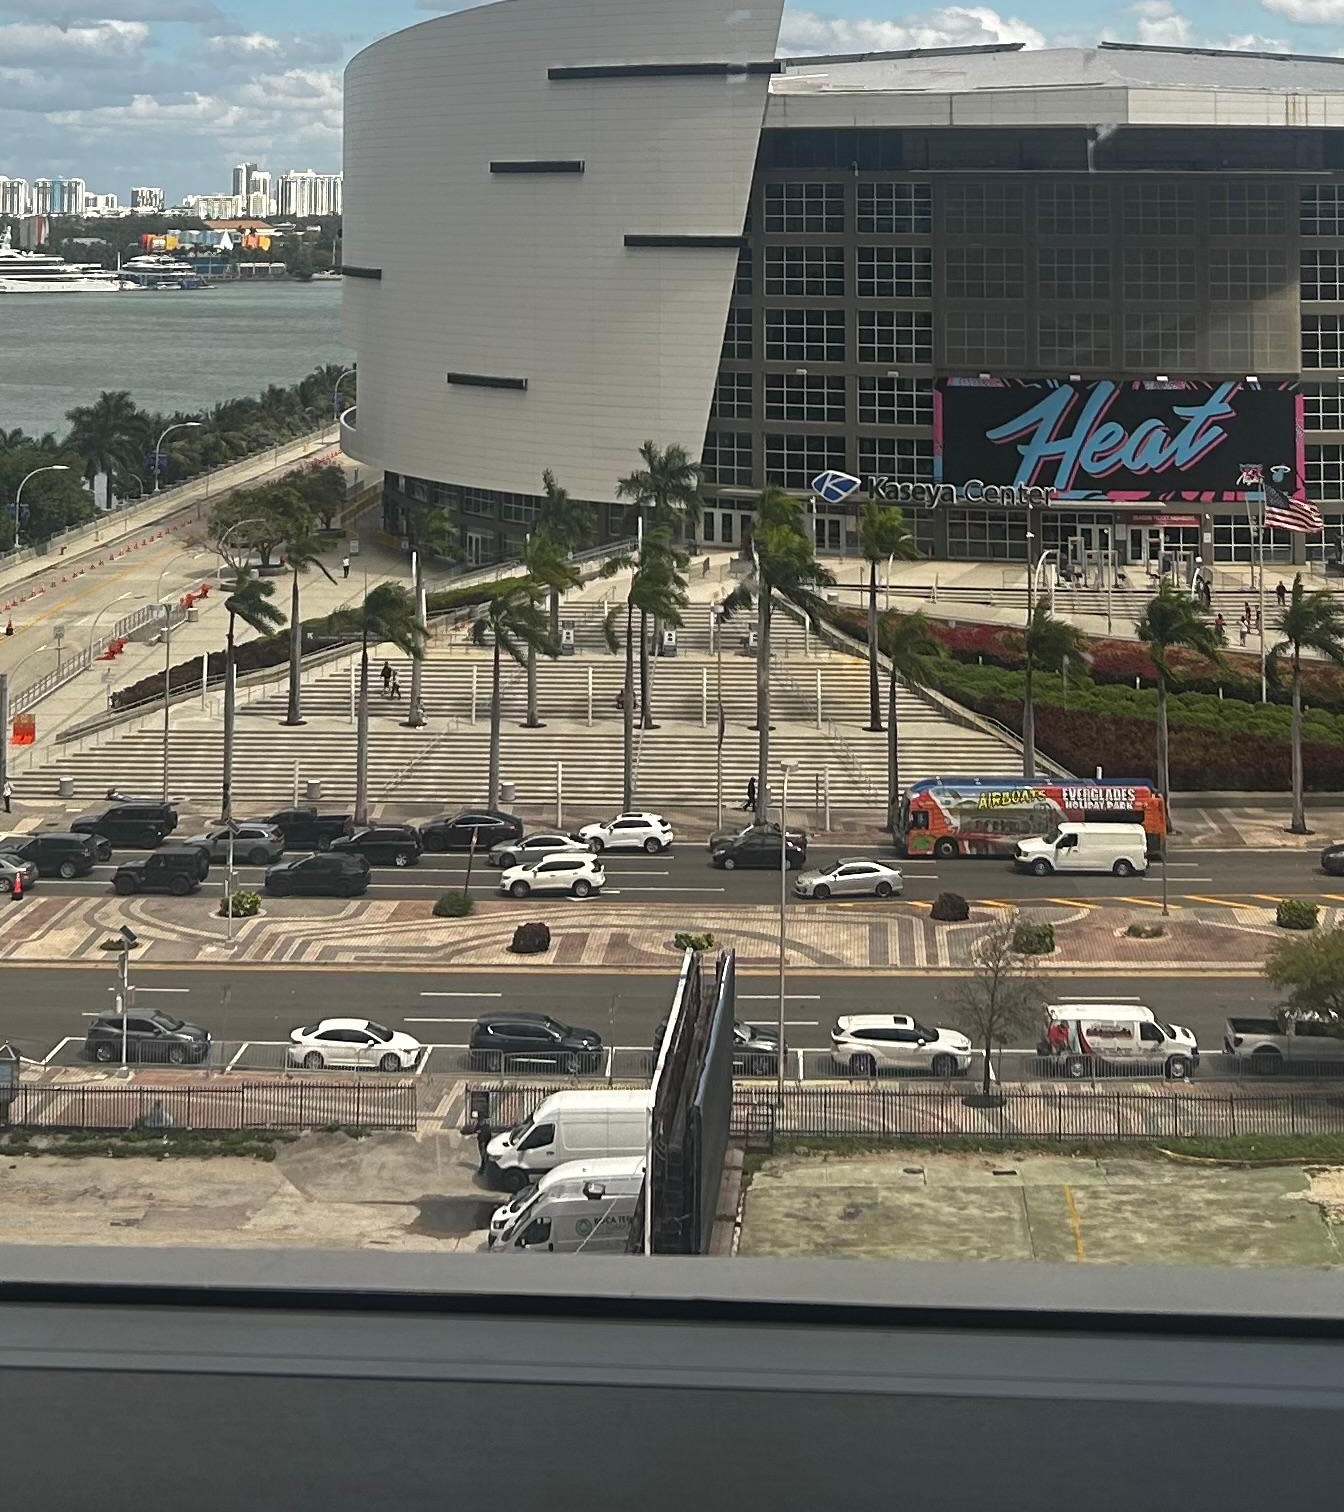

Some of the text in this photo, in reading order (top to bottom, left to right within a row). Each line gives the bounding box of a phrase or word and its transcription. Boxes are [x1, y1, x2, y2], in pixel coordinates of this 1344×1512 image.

[985, 380, 1236, 493] Heat
[867, 475, 957, 510] Kaseya
[963, 479, 1056, 507] Center
[977, 789, 1048, 810] AIRBOATS
[1062, 787, 1136, 802] EVERGLADES
[1065, 801, 1134, 810] HOLIDAY PARK
